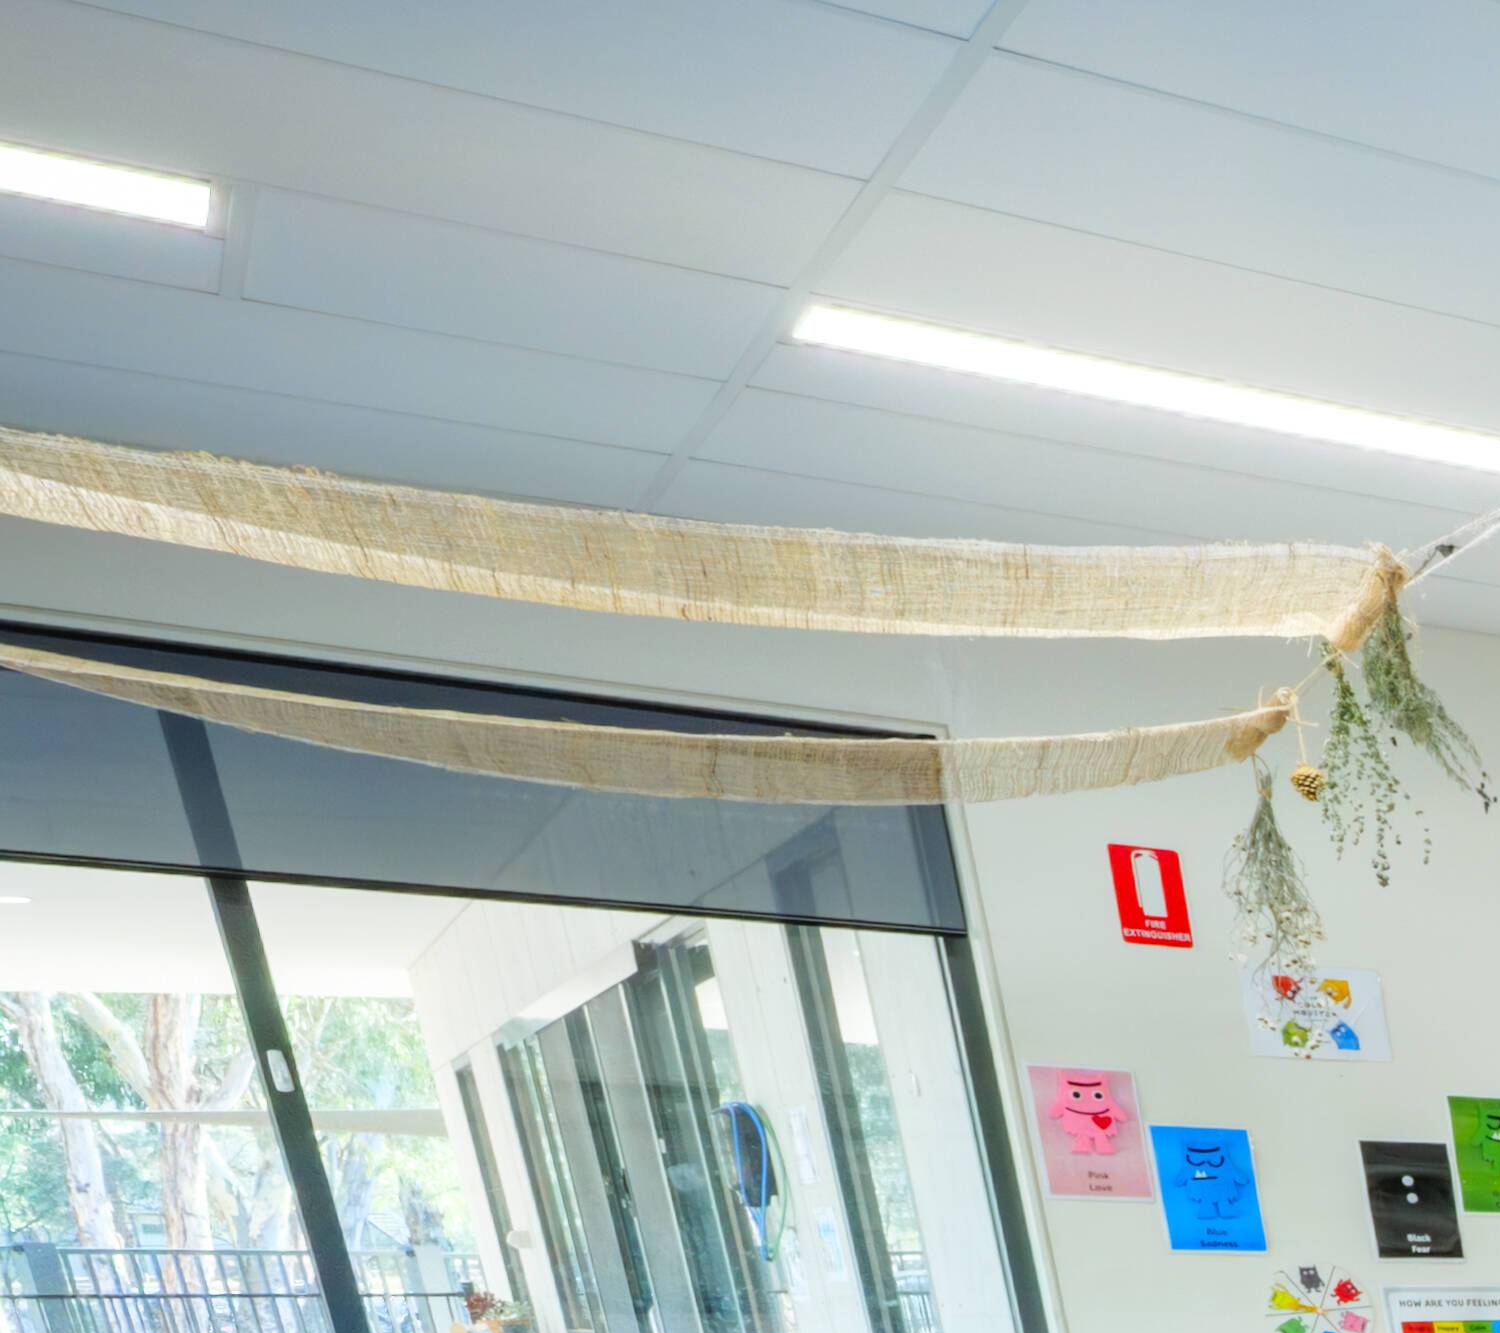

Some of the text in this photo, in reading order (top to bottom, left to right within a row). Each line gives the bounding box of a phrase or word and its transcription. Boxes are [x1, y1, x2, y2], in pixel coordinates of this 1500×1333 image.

[1145, 919, 1166, 929] FIRE
[1123, 927, 1191, 942] EXTINGUISHER
[1407, 1233, 1432, 1243] Black
[1411, 1245, 1431, 1253] Fear
[1399, 1299, 1423, 1308] HOW
[1424, 1299, 1444, 1308] ARE
[1446, 1299, 1465, 1308] YOU
